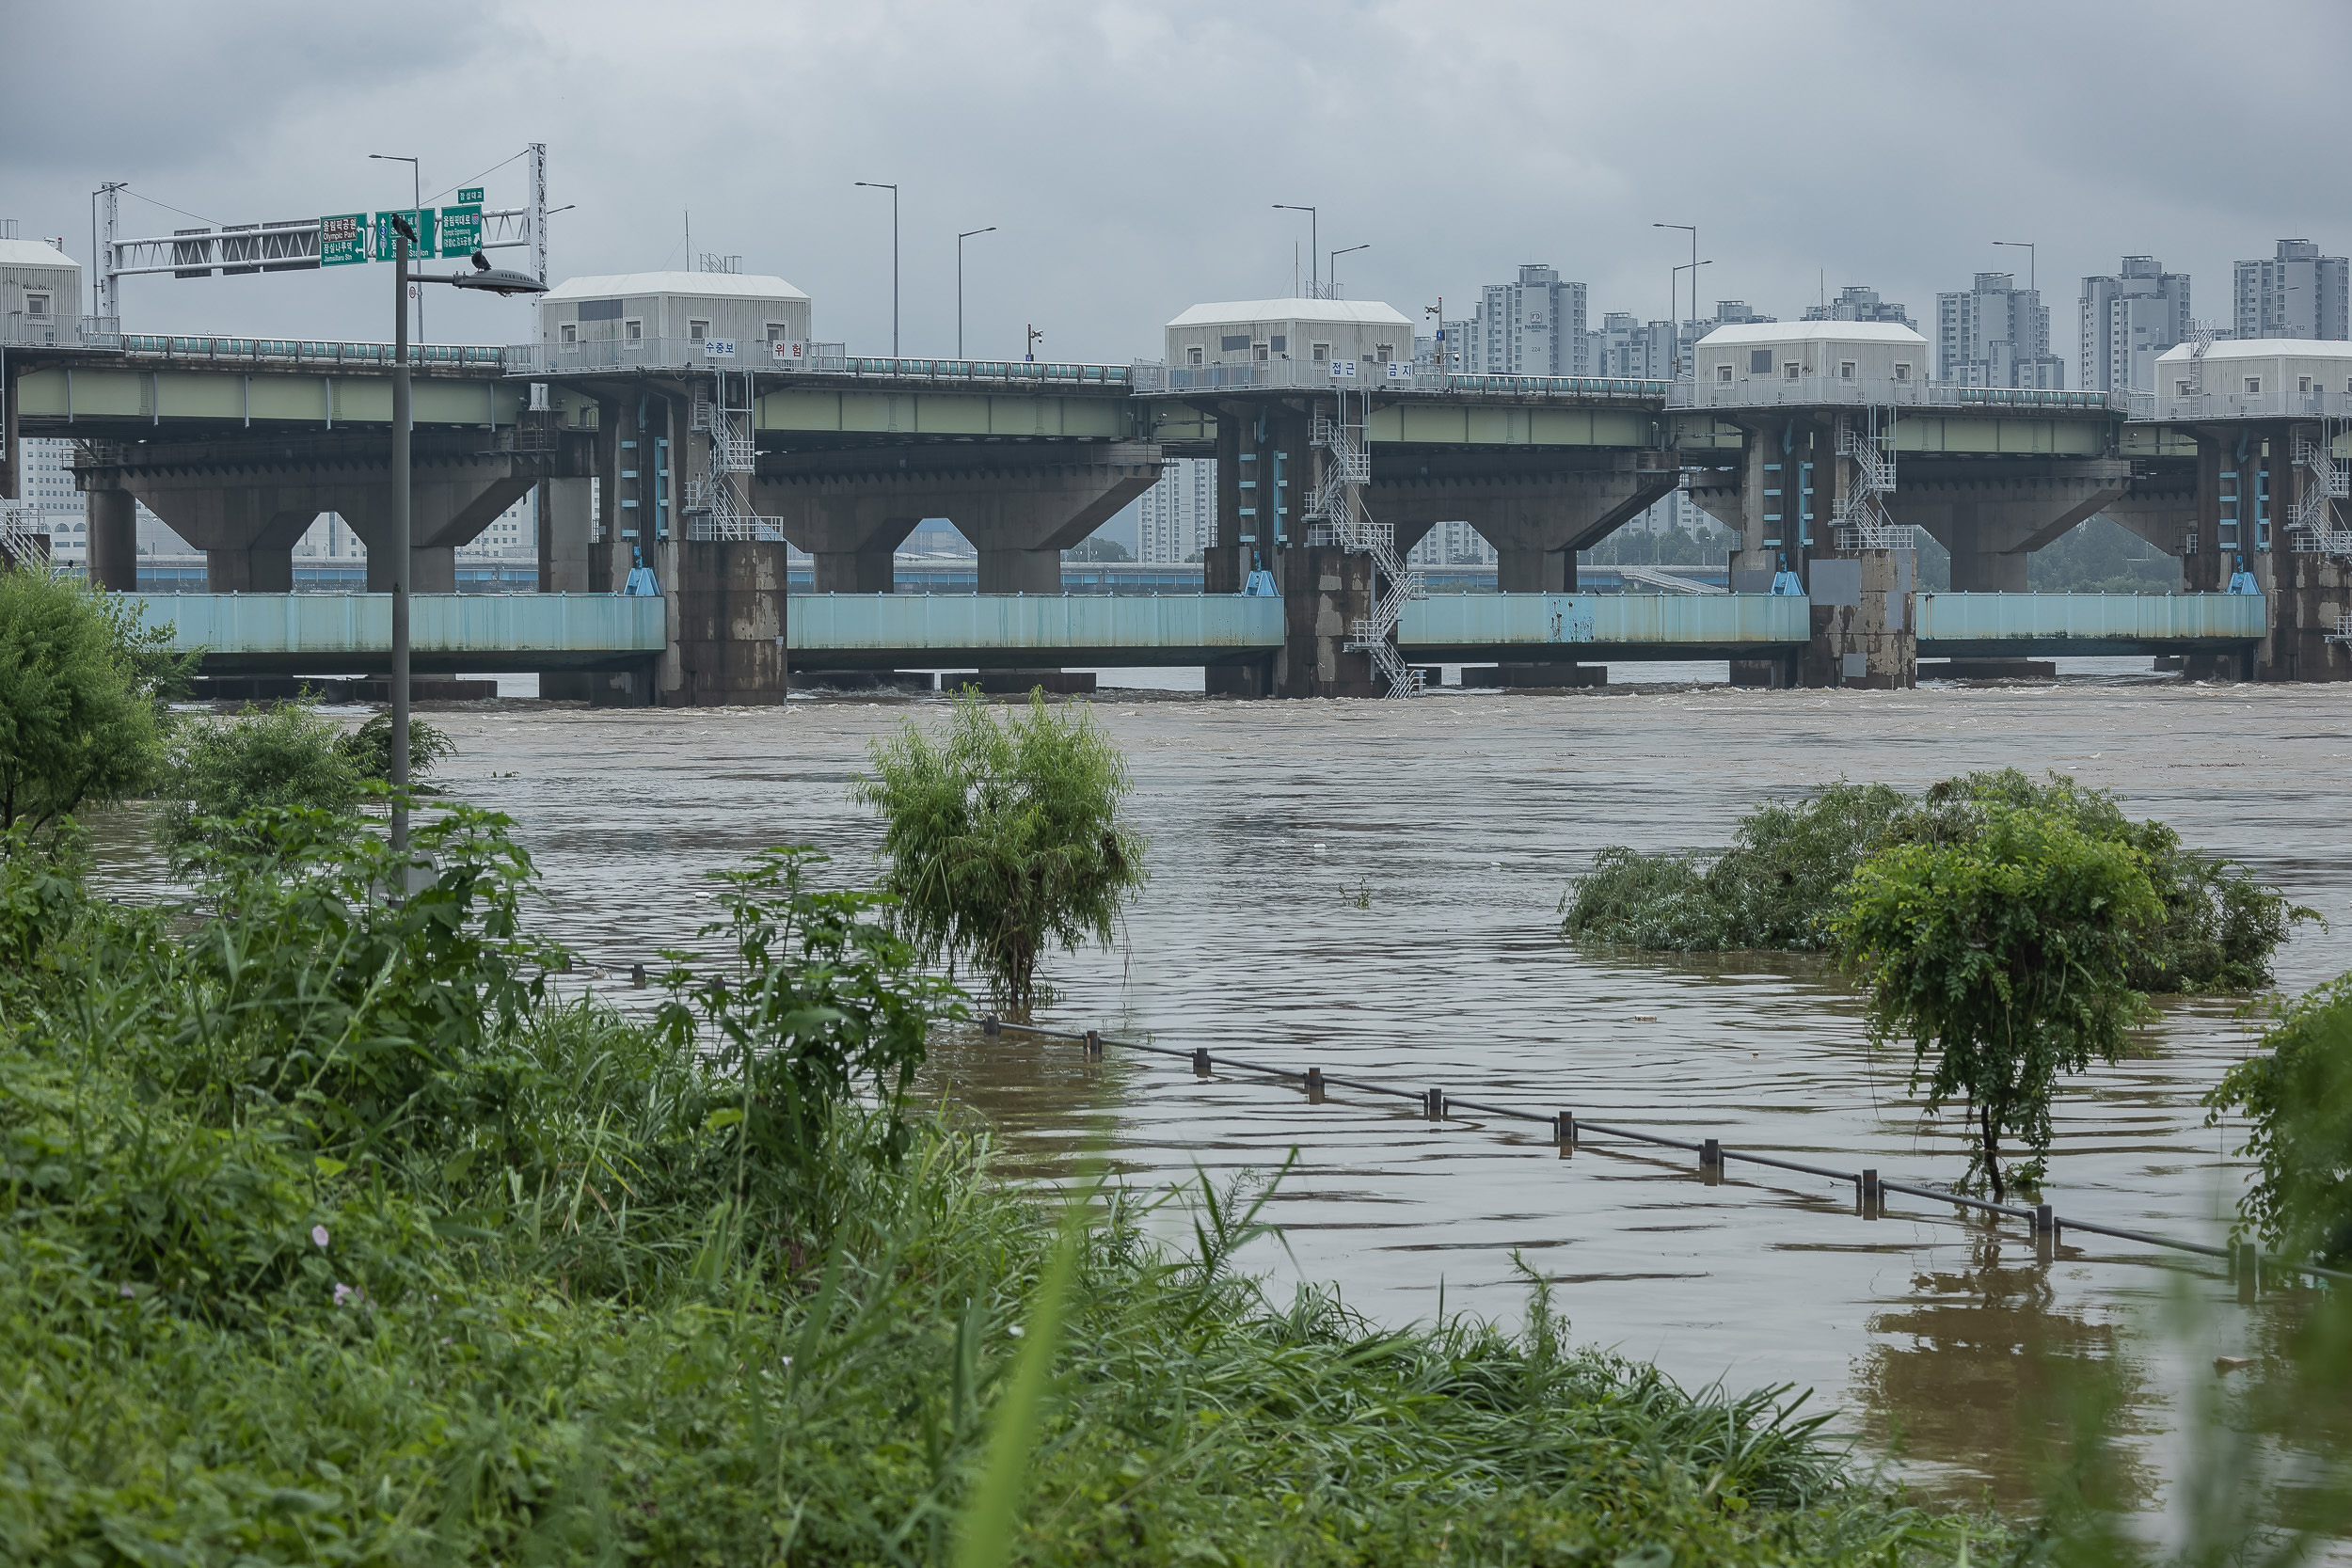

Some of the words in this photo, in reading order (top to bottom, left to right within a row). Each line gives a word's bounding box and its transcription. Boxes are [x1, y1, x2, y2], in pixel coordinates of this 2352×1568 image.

[459, 191, 483, 201] 잠실대교
[323, 218, 357, 232] 올림픽공원
[443, 214, 471, 228] 올림픽대로
[323, 231, 343, 242] Olympic
[343, 230, 357, 239] Park
[324, 241, 353, 254] 잠실나루역
[706, 341, 735, 354] 수중보
